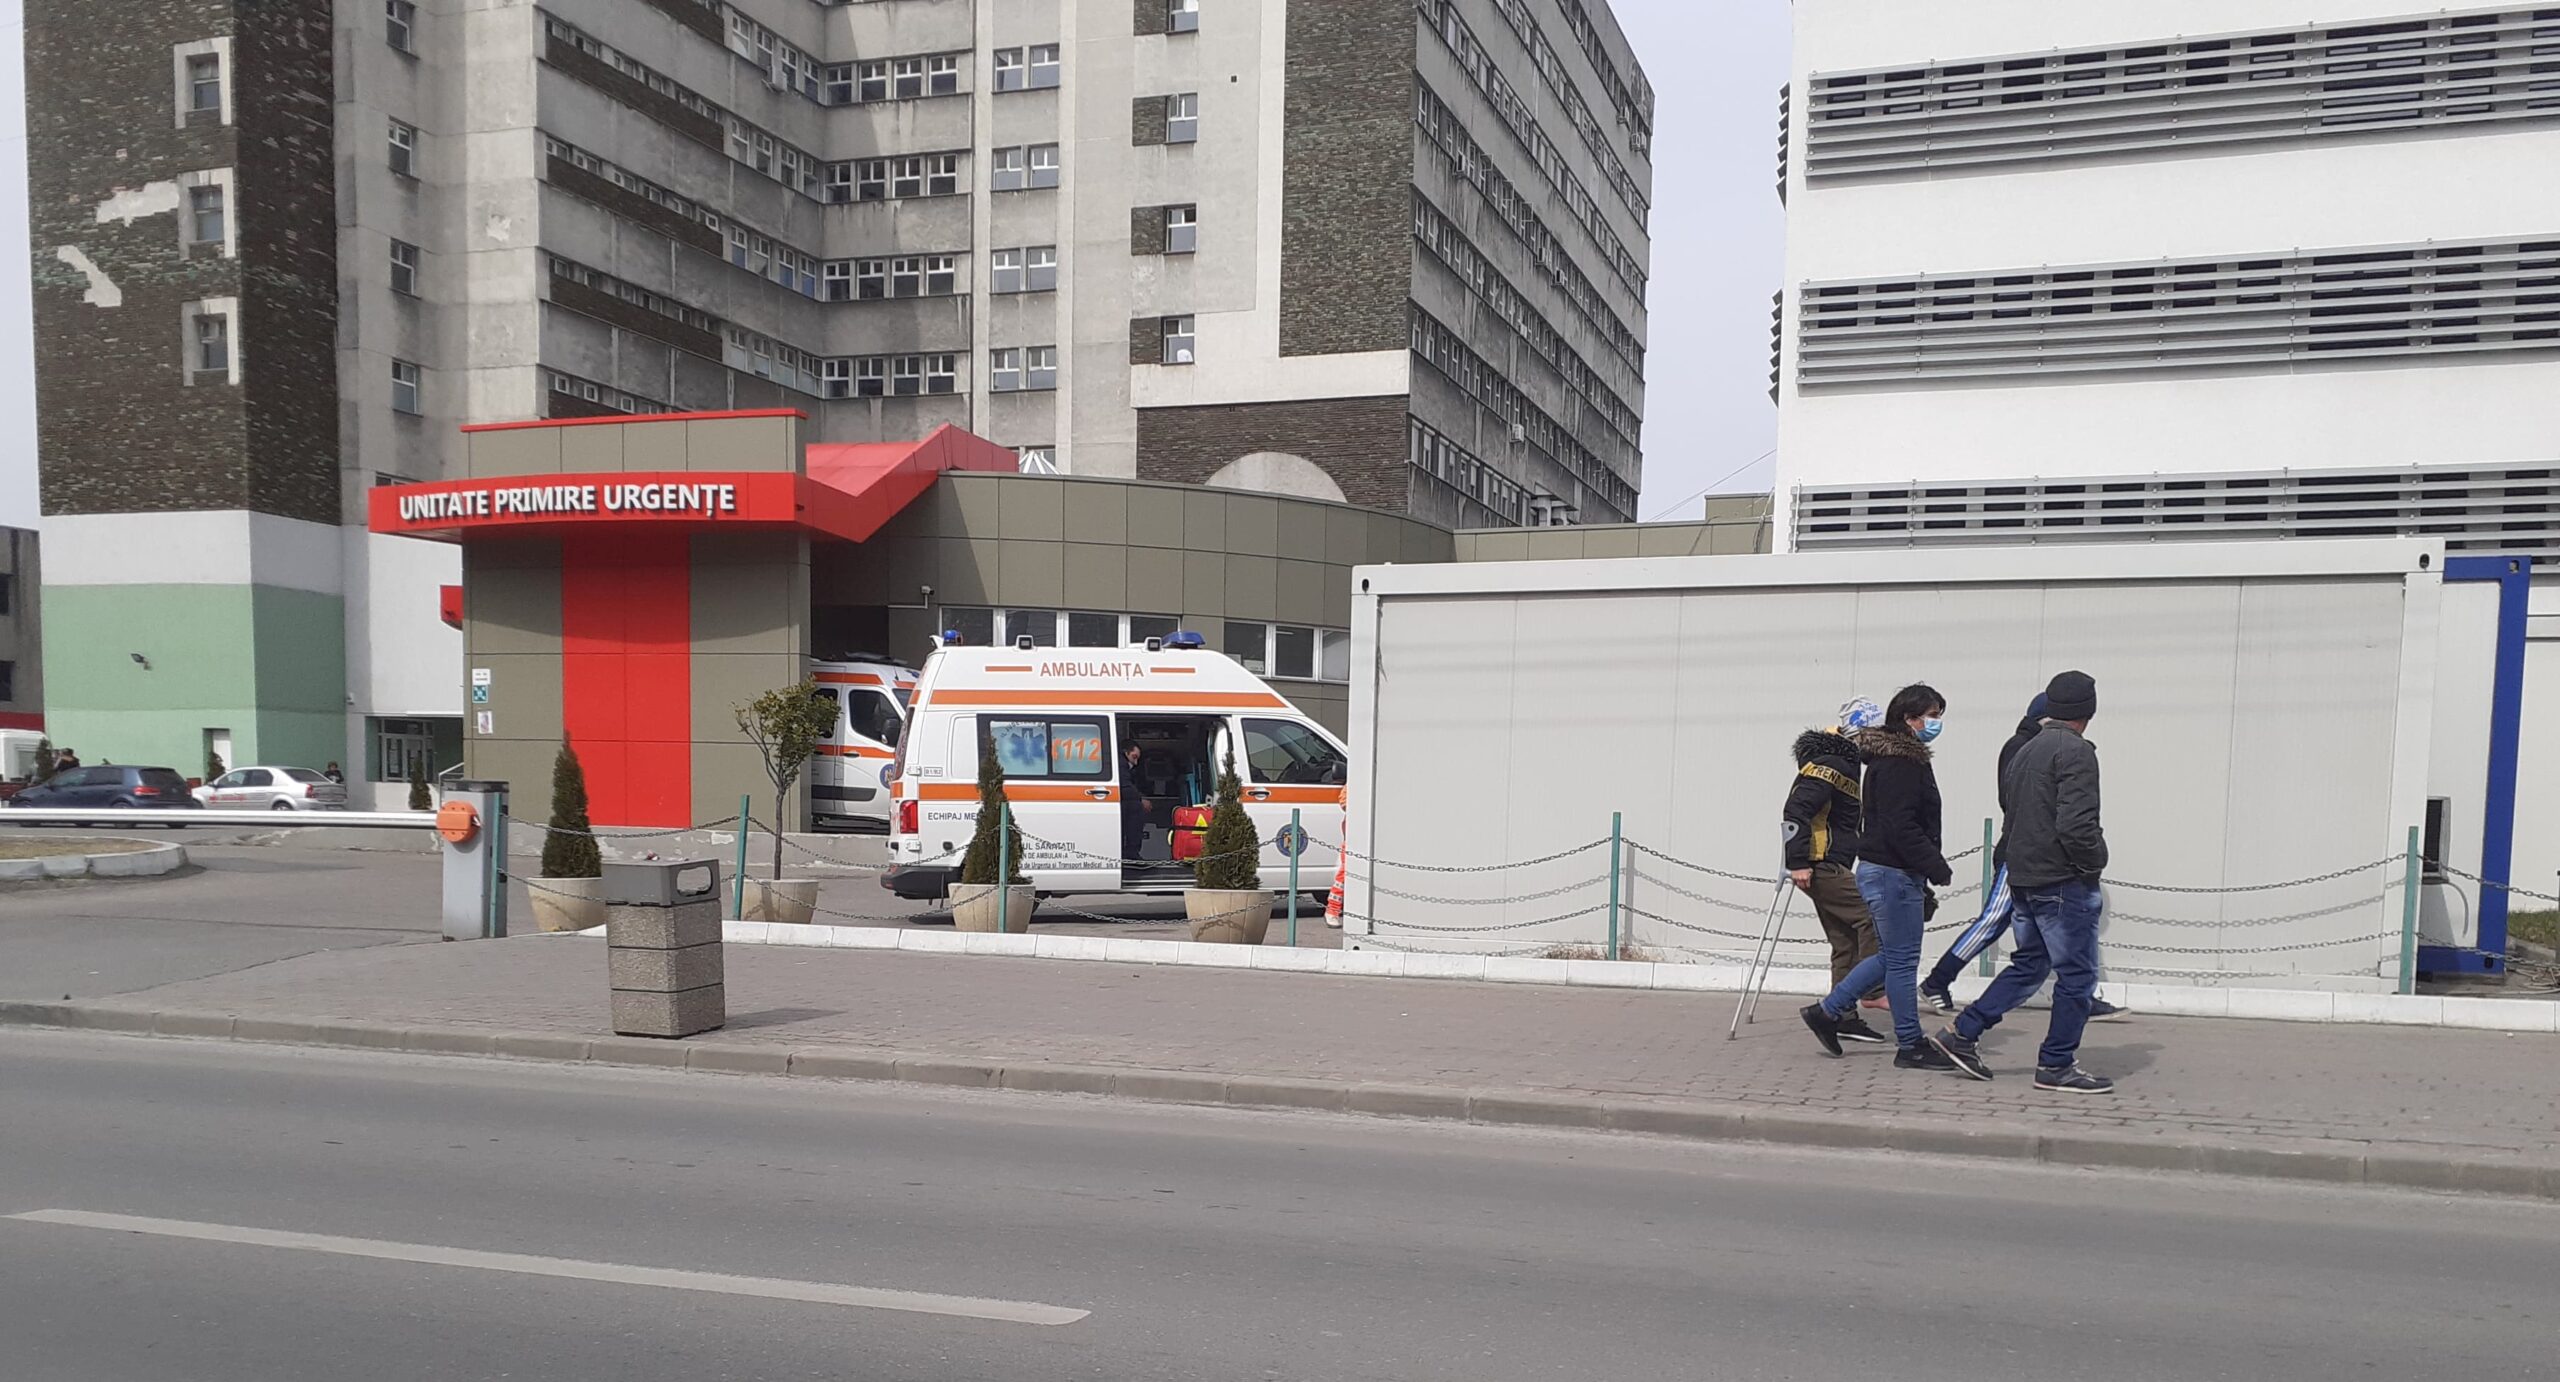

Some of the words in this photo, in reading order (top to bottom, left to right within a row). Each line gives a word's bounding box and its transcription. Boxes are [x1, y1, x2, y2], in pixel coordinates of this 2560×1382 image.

[400, 490, 488, 519] UNITATE
[495, 486, 595, 513] PRIMIRE
[604, 484, 734, 517] URGENȚE
[1040, 662, 1144, 681] AMBULANȚA
[1062, 738, 1103, 761] 112
[928, 812, 962, 821] ECHIPAJ
